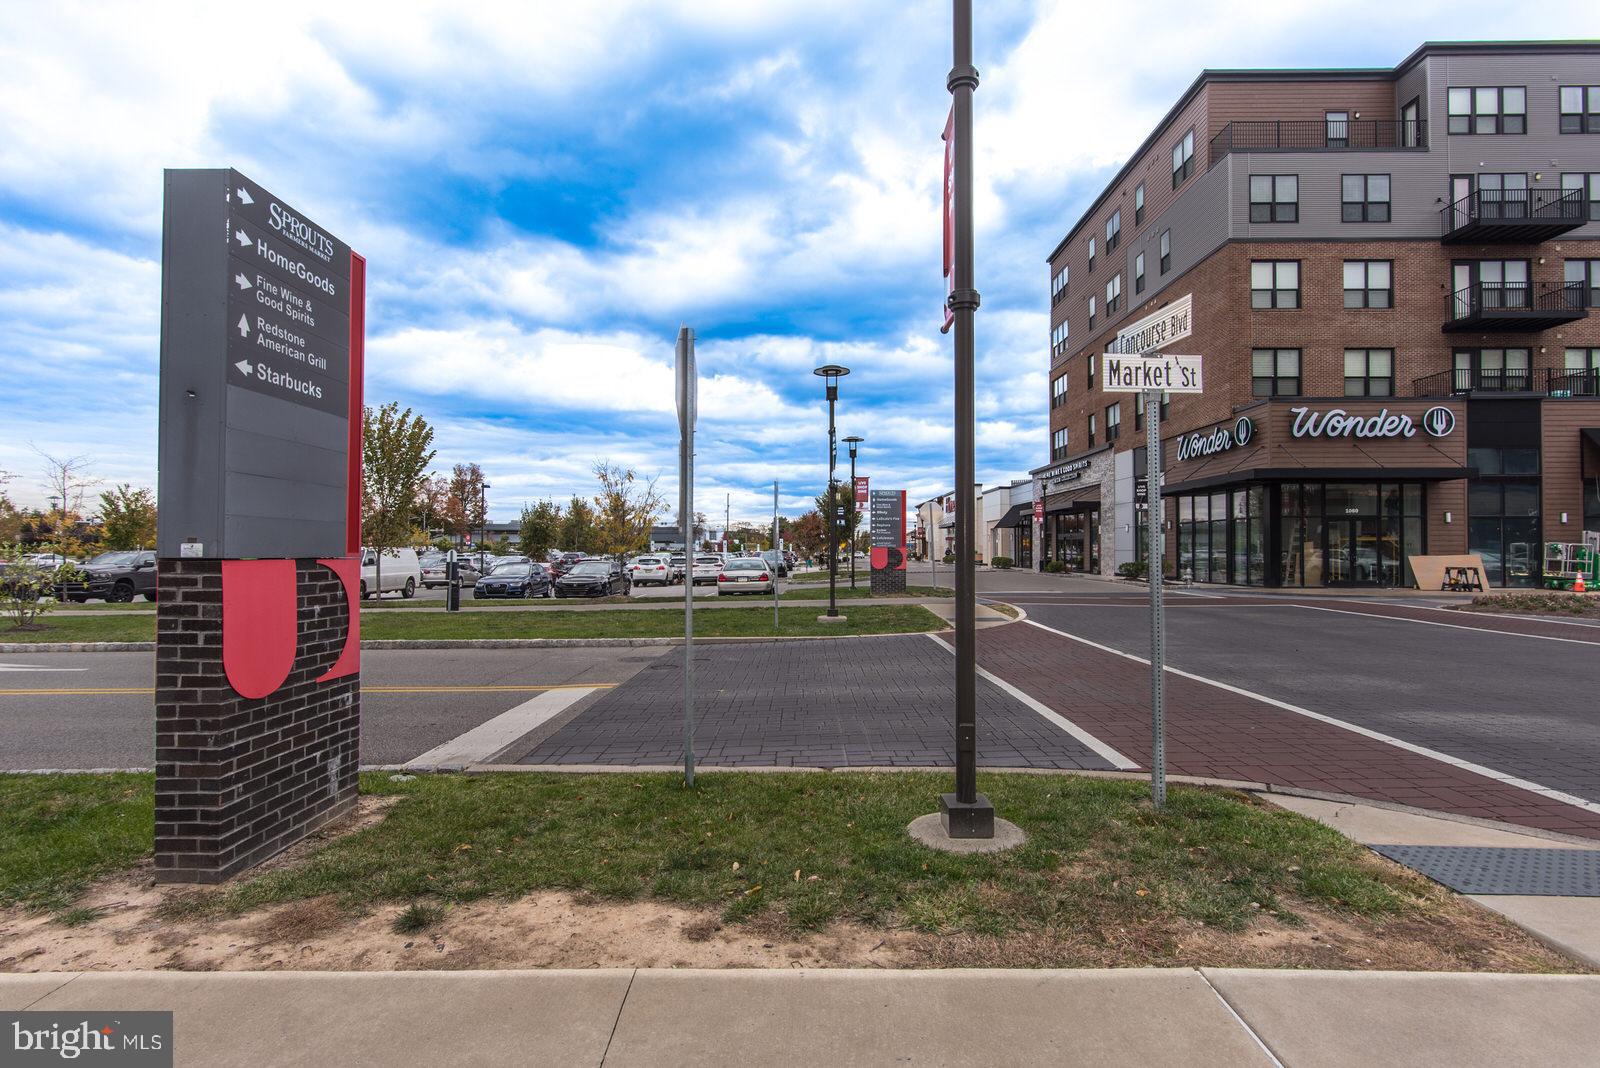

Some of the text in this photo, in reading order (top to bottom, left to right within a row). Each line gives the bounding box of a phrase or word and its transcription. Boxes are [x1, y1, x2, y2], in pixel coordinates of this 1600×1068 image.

[268, 203, 334, 257] SPROUTS
[283, 229, 331, 263] FARMERS MARKET
[257, 238, 335, 296] HomeGoods
[256, 290, 315, 328] Good Spirits
[257, 274, 313, 313] Fine Wine &
[257, 316, 306, 348] Redstone
[1120, 310, 1188, 355] Concourse Blvd
[257, 333, 327, 371] American Grill
[257, 363, 322, 399] Starbucks
[1108, 359, 1197, 388] Market St
[1290, 405, 1417, 438] Wonder
[1176, 426, 1232, 462] Wonder
